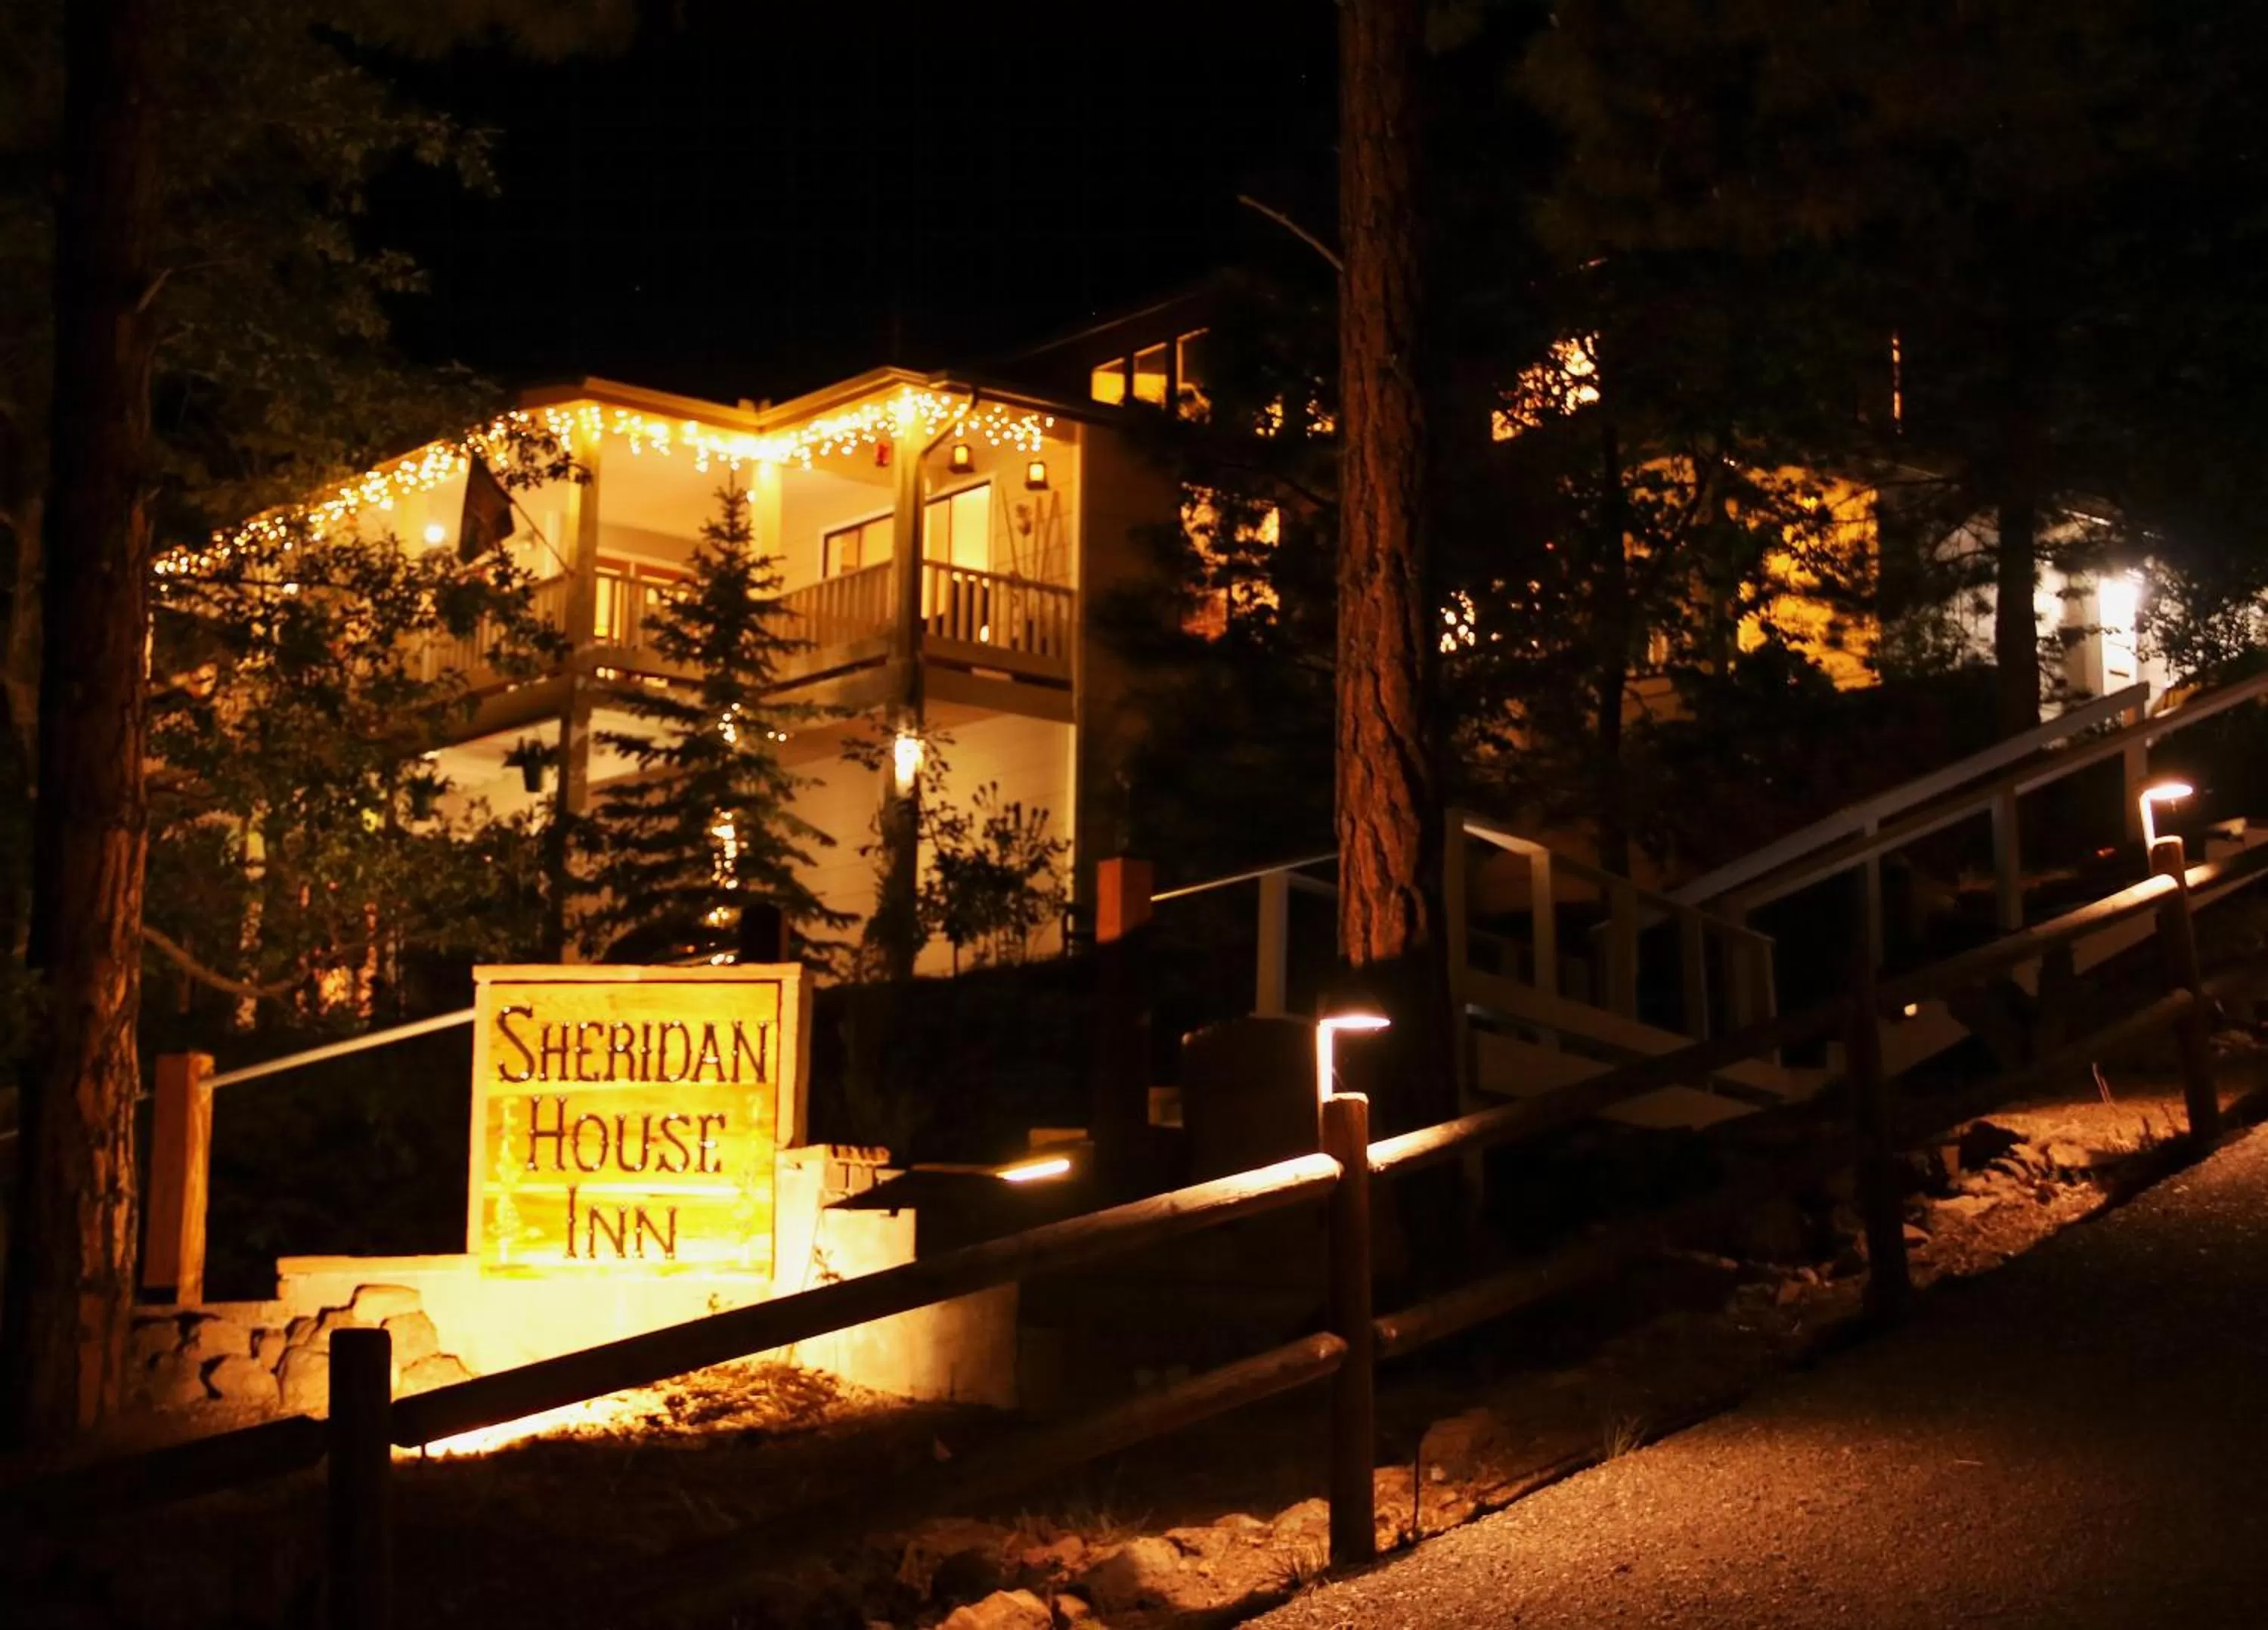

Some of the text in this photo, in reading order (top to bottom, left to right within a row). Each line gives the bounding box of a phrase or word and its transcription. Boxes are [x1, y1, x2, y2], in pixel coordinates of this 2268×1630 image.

[497, 1006, 771, 1083] SHERIDAN
[527, 1095, 726, 1173] HOUSE
[565, 1185, 677, 1259] INN
